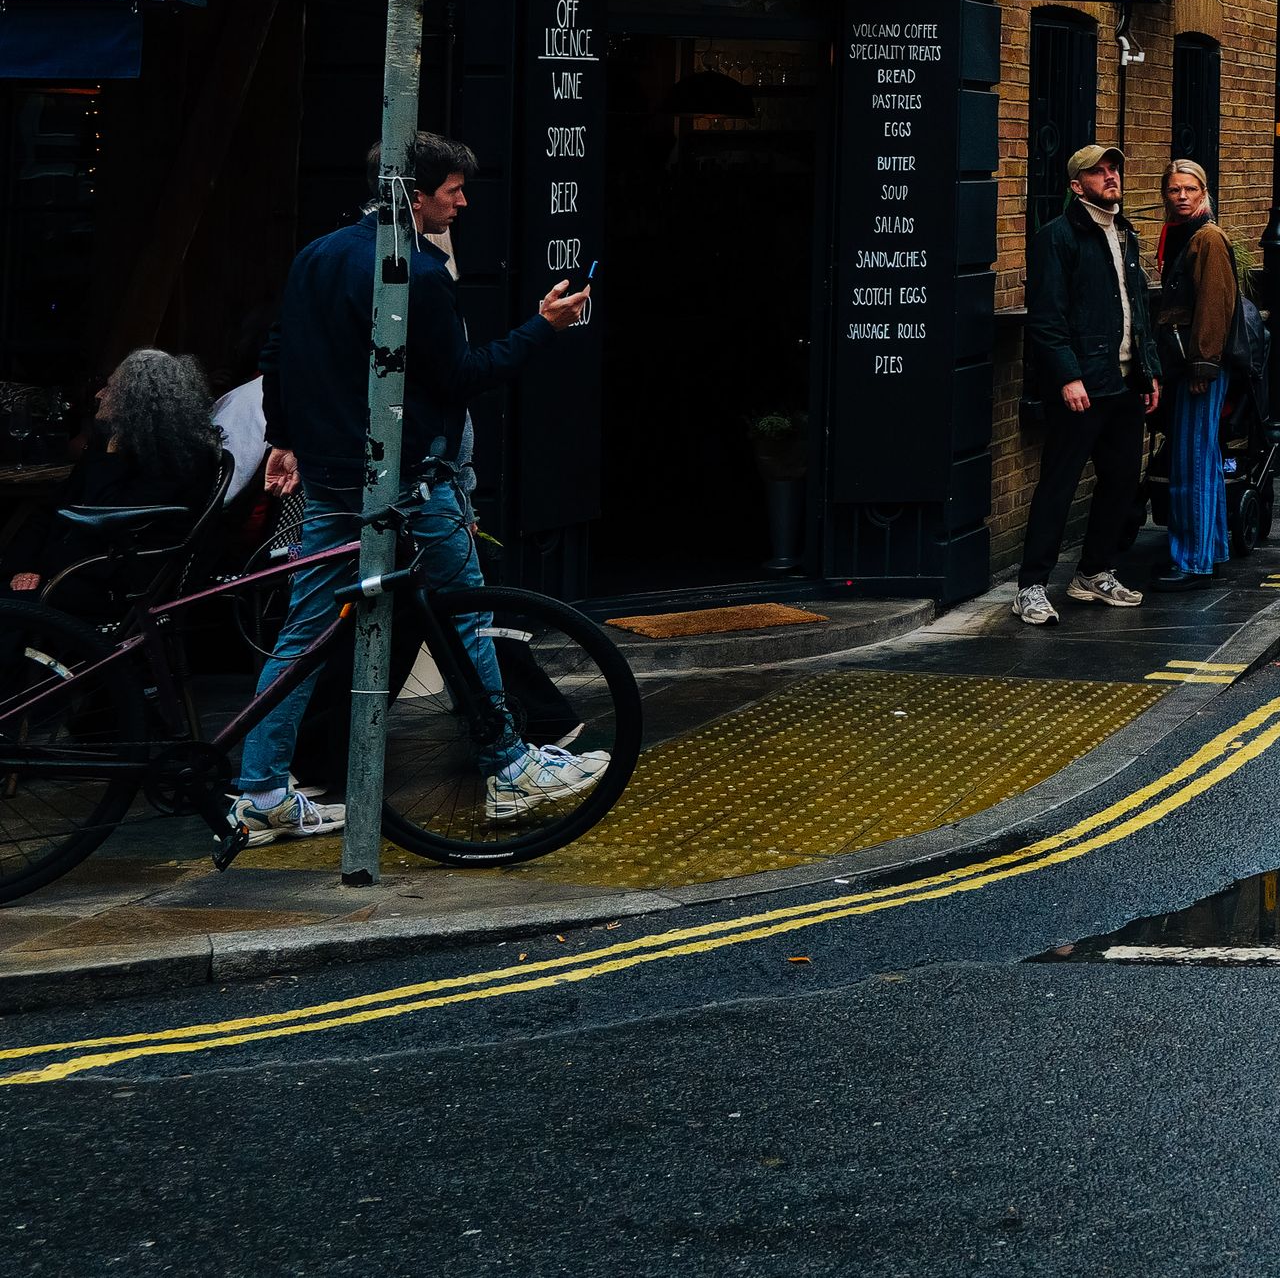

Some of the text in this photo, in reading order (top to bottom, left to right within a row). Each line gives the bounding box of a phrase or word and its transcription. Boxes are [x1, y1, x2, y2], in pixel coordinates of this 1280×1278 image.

[556, 0, 579, 28] OFF
[852, 23, 938, 39] VOLCANO COFFEE
[545, 28, 594, 56] LICENCE
[849, 43, 942, 62] SPECIALITY TREATS
[552, 71, 584, 100] WINE
[877, 68, 916, 84] BREAD
[872, 94, 922, 110] PASTRIES
[884, 121, 912, 137] EGGS
[546, 125, 586, 158] SPIRITS
[877, 155, 916, 171] BUTTER
[550, 181, 578, 214] BEER
[880, 184, 909, 201] SOUP
[873, 215, 915, 234] SALADS
[547, 238, 581, 271] CIDER
[855, 249, 927, 268] SANDWICHES
[852, 286, 927, 306] SCOTCH EGGS
[846, 322, 926, 340] SAUSAGE ROLLS
[874, 355, 904, 374] PIES
